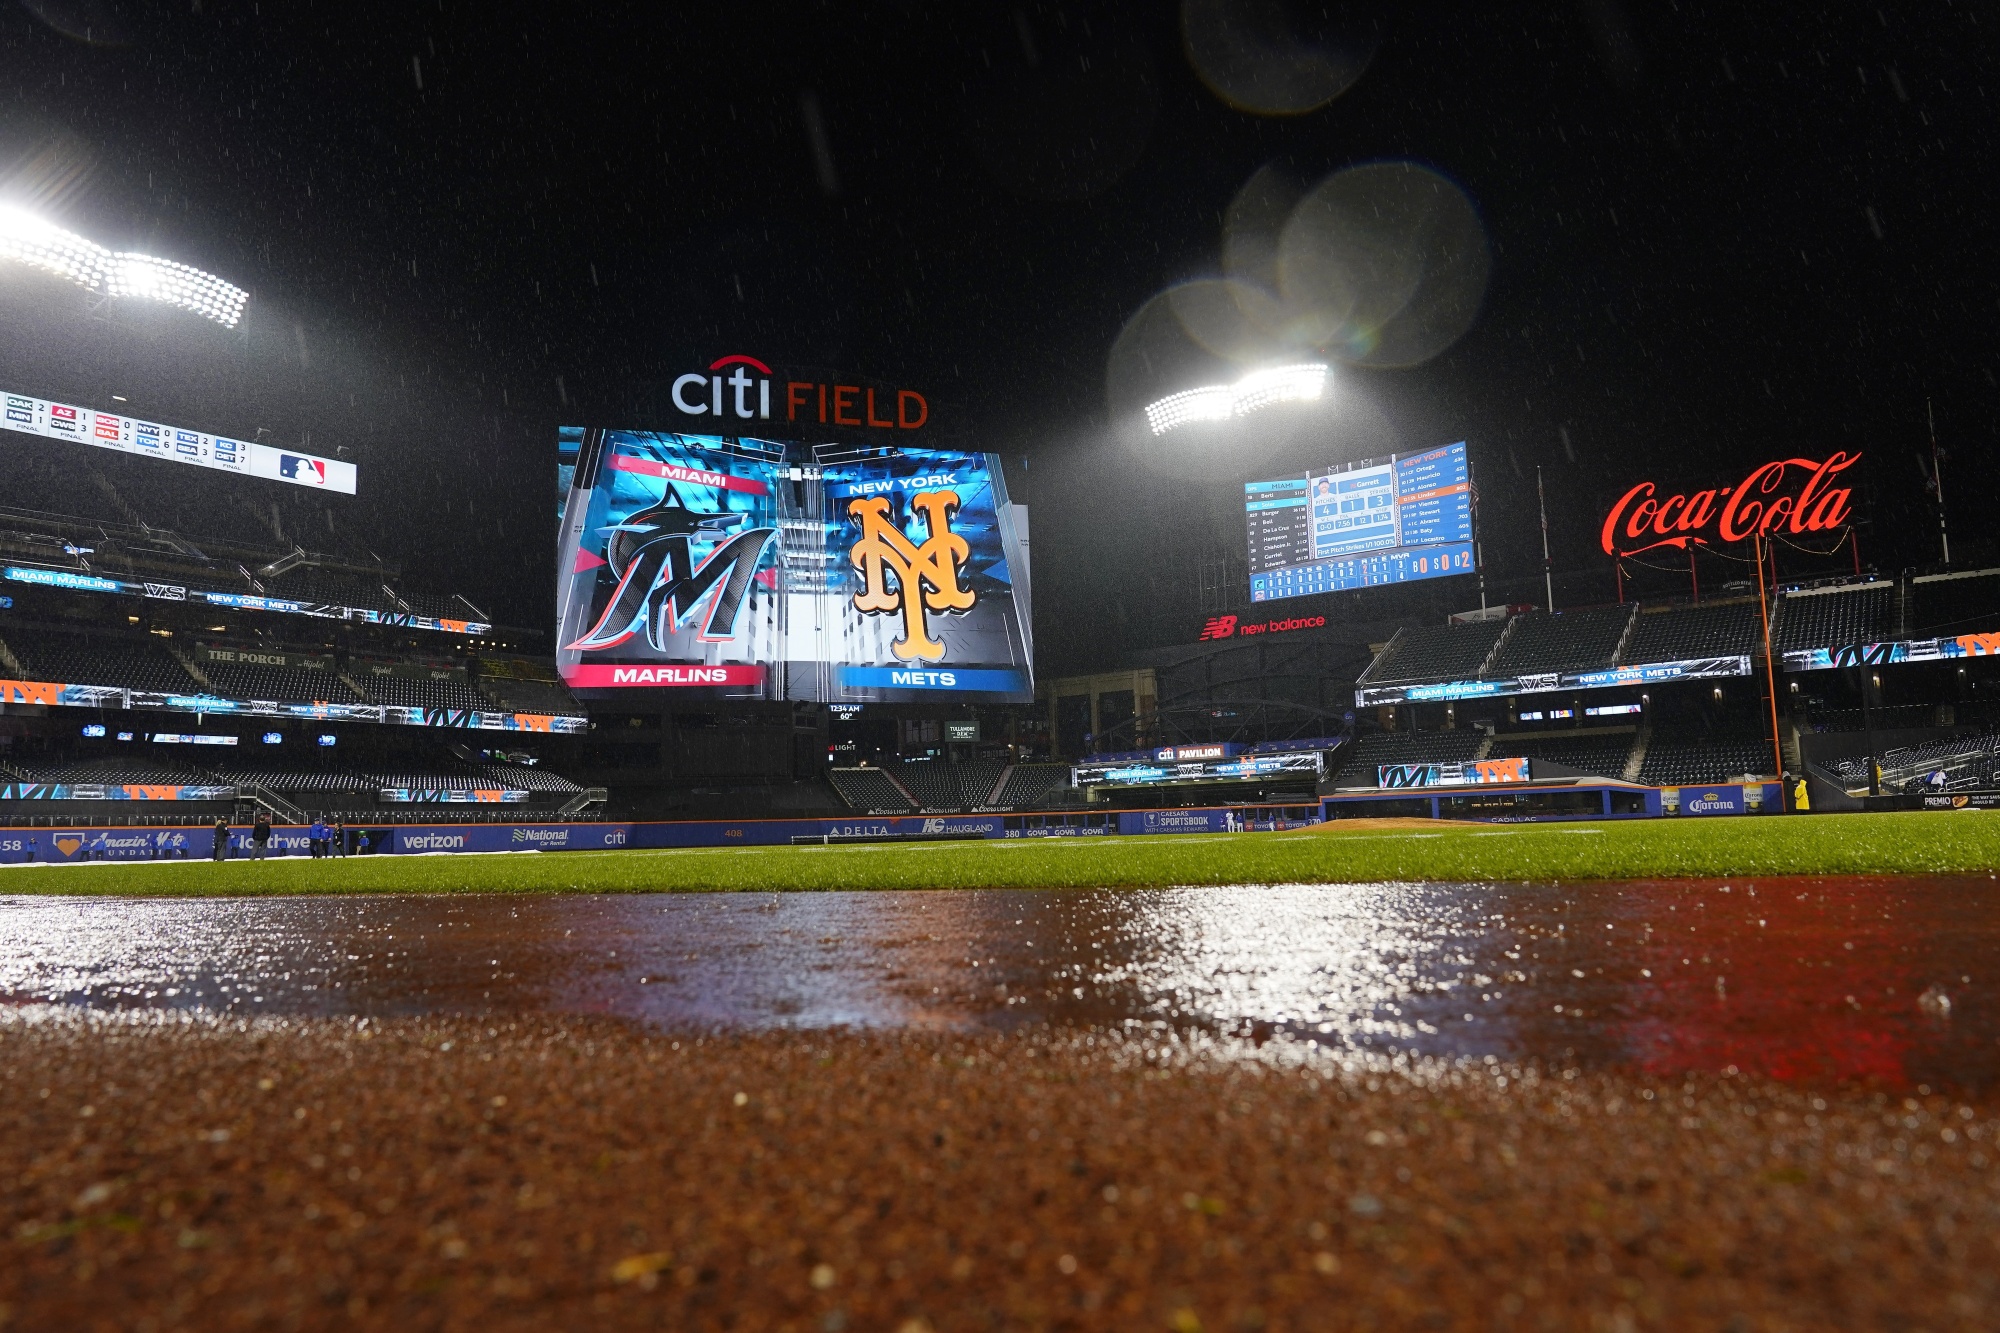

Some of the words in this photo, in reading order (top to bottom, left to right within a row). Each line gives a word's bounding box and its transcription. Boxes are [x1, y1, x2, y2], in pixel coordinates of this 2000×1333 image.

[671, 365, 770, 420] citi
[787, 381, 929, 430] FIELD
[8, 398, 33, 409] OAK
[8, 411, 31, 421] MIN
[56, 409, 73, 417] AZ
[51, 419, 76, 430] CWS
[96, 416, 119, 427] BOS
[16, 424, 39, 432] FINAL
[97, 428, 118, 438] BAL
[138, 424, 159, 435] NYY
[60, 432, 82, 440] FINAL
[179, 433, 198, 443] TEX
[137, 437, 159, 447] TOR
[217, 452, 236, 461] DET
[1404, 457, 1422, 467] NEW
[1424, 449, 1447, 461] YORK
[1416, 465, 1435, 473] Ortega
[661, 466, 726, 487] MIAMI
[849, 480, 893, 495] NEW
[900, 473, 957, 489] YORK
[1357, 479, 1379, 488] Garrett
[1377, 496, 1384, 506] 3
[1601, 451, 1862, 557] Coca-Cola
[1323, 505, 1330, 515] 4
[1346, 543, 1364, 551] Strikes
[1391, 552, 1410, 560] MVR
[1413, 561, 1418, 573] B
[1420, 557, 1428, 574] 0
[1441, 554, 1449, 571] 0
[1461, 551, 1470, 568] 2
[12, 571, 52, 582] MIAMI
[57, 576, 116, 589] MARLINS
[144, 583, 187, 600] VS
[207, 594, 233, 603] NEW
[236, 597, 266, 607] YORK
[269, 601, 299, 611] METS
[1240, 624, 1267, 635] new
[1270, 616, 1325, 632] balance
[208, 650, 235, 661] THE
[239, 652, 286, 665] PORCH
[613, 668, 728, 683] MARLINS
[892, 671, 956, 686] METS
[1412, 688, 1443, 698] MIAMI
[1446, 684, 1495, 694] MARLINS
[1518, 675, 1559, 691] VS
[1579, 674, 1607, 683] NEW
[1610, 671, 1643, 680] YORK
[1646, 668, 1681, 677] METS
[199, 700, 234, 708] MARLINS
[251, 700, 278, 713] VS
[1158, 750, 1174, 760] citi
[1179, 748, 1221, 758] PAVILION
[1130, 769, 1163, 777] MARLINS
[1177, 764, 1204, 777] VS
[1238, 763, 1258, 771] YORK
[1259, 762, 1281, 770] METS
[1689, 799, 1734, 813] Corona
[1924, 797, 1951, 806] PREMIO
[927, 806, 945, 814] Coors
[978, 805, 996, 813] Coors
[1161, 817, 1208, 826] SPORTSBOOK
[1308, 818, 1321, 826] 370
[724, 829, 743, 837] 408
[845, 826, 888, 835] DELTA
[946, 824, 993, 834] HAUGLAND
[1005, 830, 1020, 838] 380
[404, 832, 463, 848] verizon
[525, 829, 568, 841] National
[605, 830, 626, 844] citi
[0, 840, 22, 851] 58
